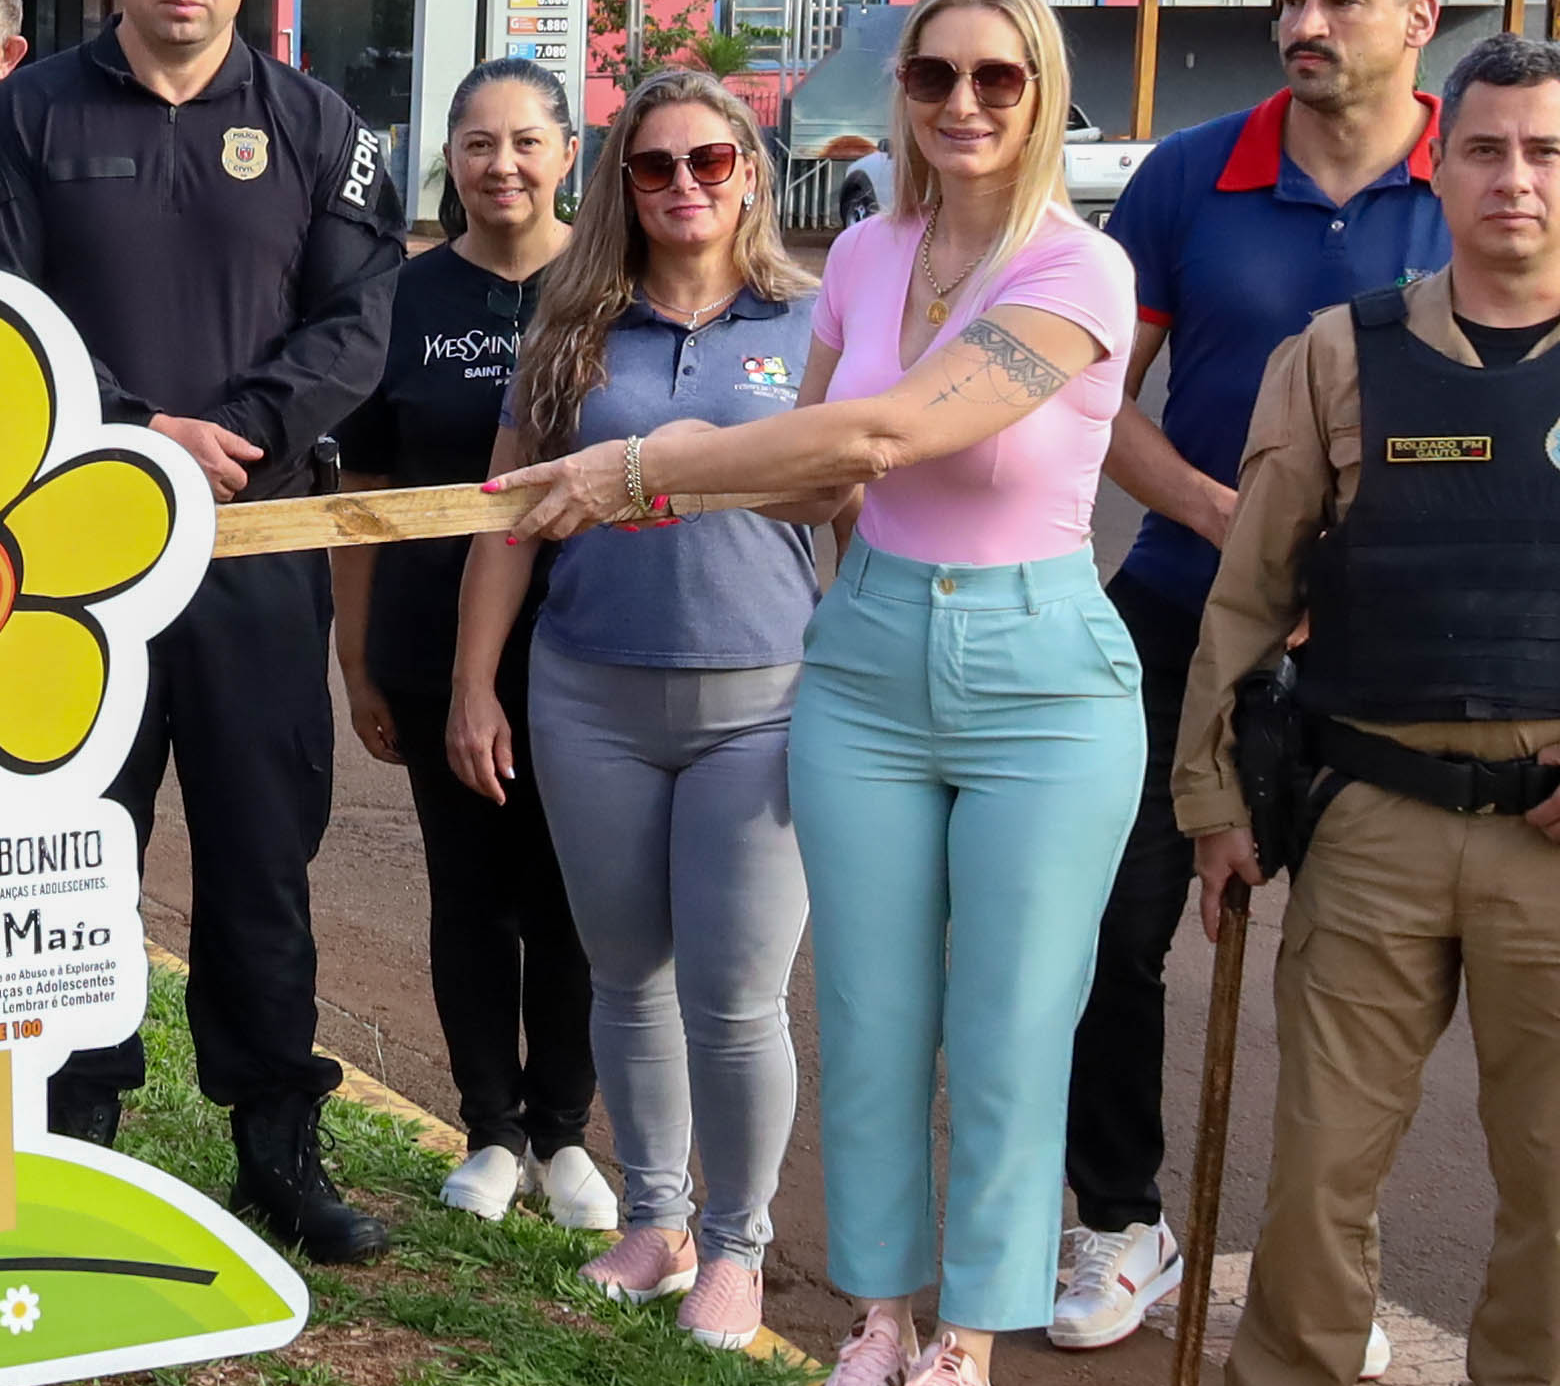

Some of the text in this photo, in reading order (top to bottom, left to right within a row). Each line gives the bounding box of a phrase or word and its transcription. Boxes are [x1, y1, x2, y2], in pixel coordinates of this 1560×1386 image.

[537, 19, 567, 32] 6.880
[535, 45, 566, 58] 7.080
[343, 128, 379, 207] PCPR
[464, 364, 503, 379] SAINT
[1395, 440, 1483, 451] SOLDADO PM
[1416, 449, 1461, 458] GAUTO
[31, 884, 37, 896] E
[40, 877, 109, 894] ADOLESCENTES.
[3, 908, 111, 958] Maio
[5, 973, 17, 982] ao
[19, 967, 48, 980] Abuso
[49, 968, 56, 976] e
[57, 964, 63, 975] à
[66, 959, 116, 976] Exploração
[26, 987, 33, 995] e
[36, 975, 115, 994] Adolescentes
[2, 998, 48, 1014] Lembrar
[51, 996, 58, 1008] é
[61, 989, 116, 1007] Combater
[12, 1018, 43, 1039] 100
